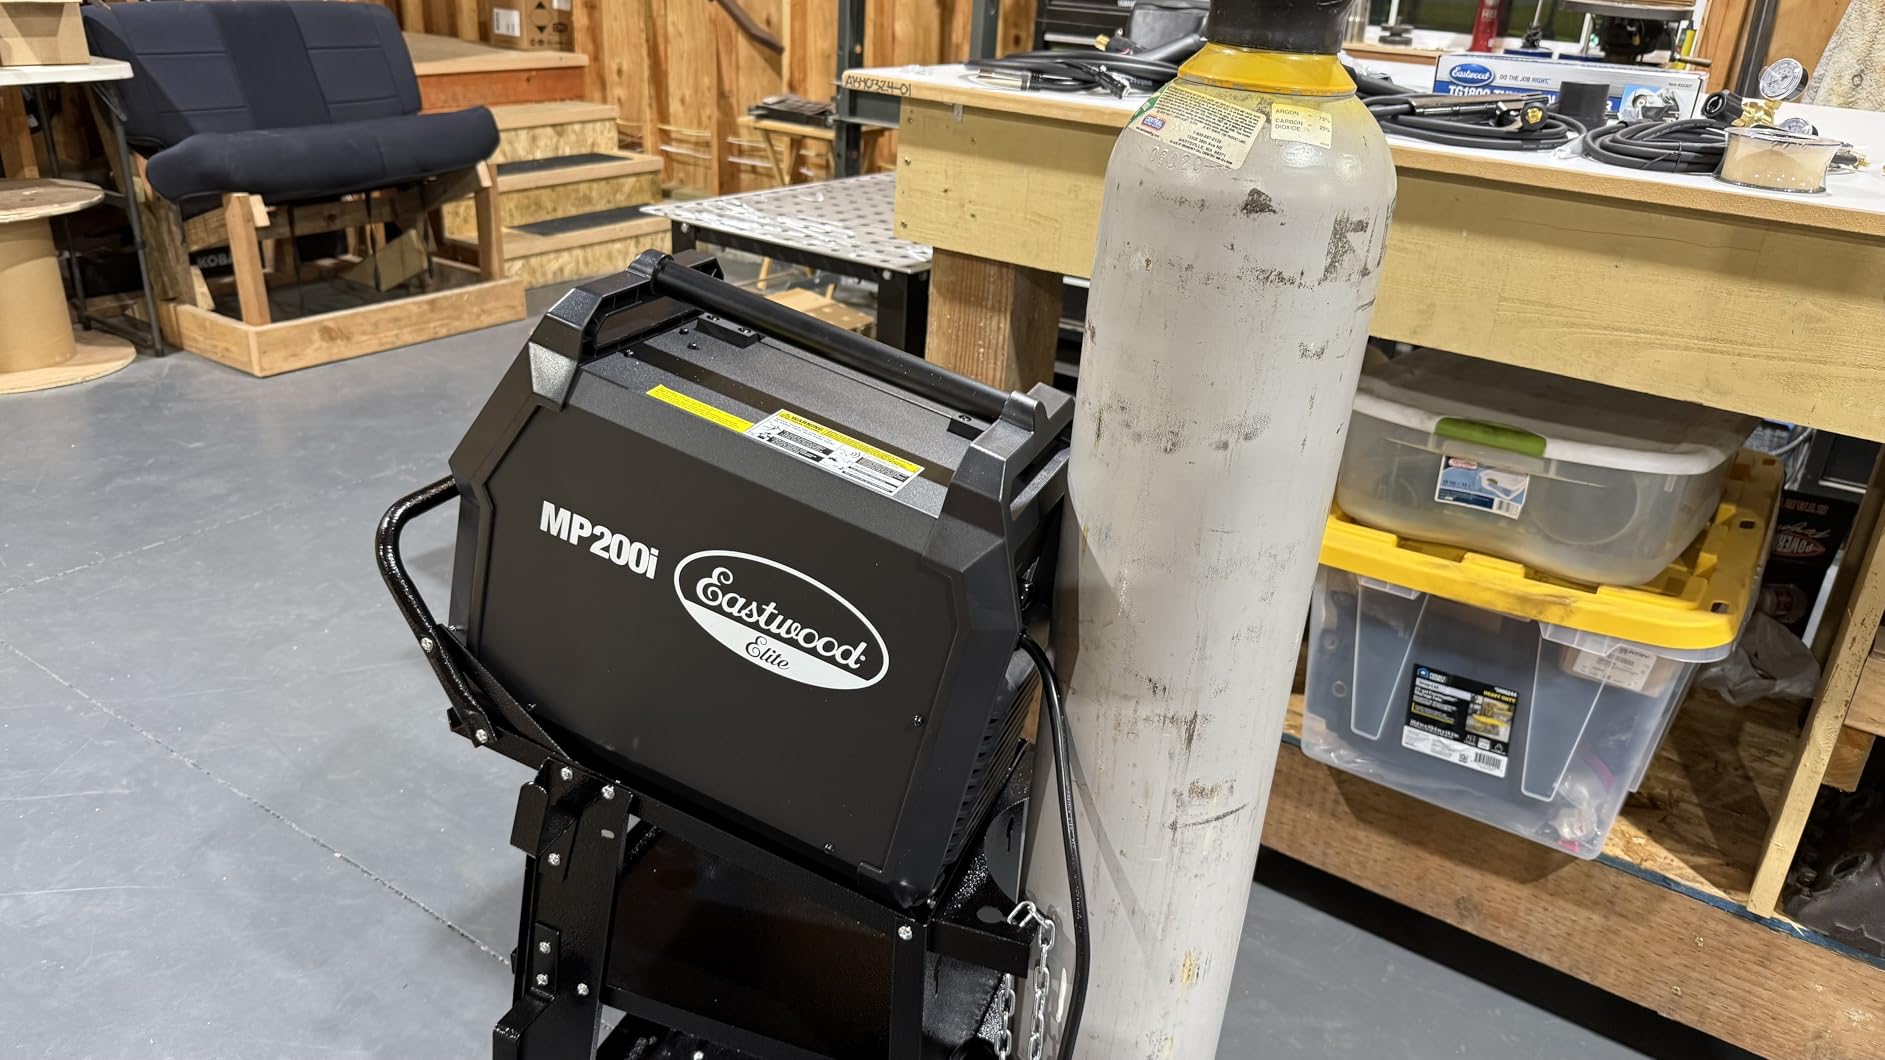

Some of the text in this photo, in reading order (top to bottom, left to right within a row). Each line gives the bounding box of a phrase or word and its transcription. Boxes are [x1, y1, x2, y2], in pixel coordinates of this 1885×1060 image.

[1451, 67, 1491, 80] Eastwood
[1509, 74, 1519, 82] THE
[1520, 75, 1531, 83] JOB
[1275, 108, 1299, 116] ARGON
[1274, 117, 1303, 126] CARBON
[1274, 123, 1301, 132] DIOXIDE
[791, 415, 824, 432] WARNING
[540, 500, 659, 580] MP200i
[696, 566, 867, 669] Eastwood
[745, 635, 791, 670] Elite
